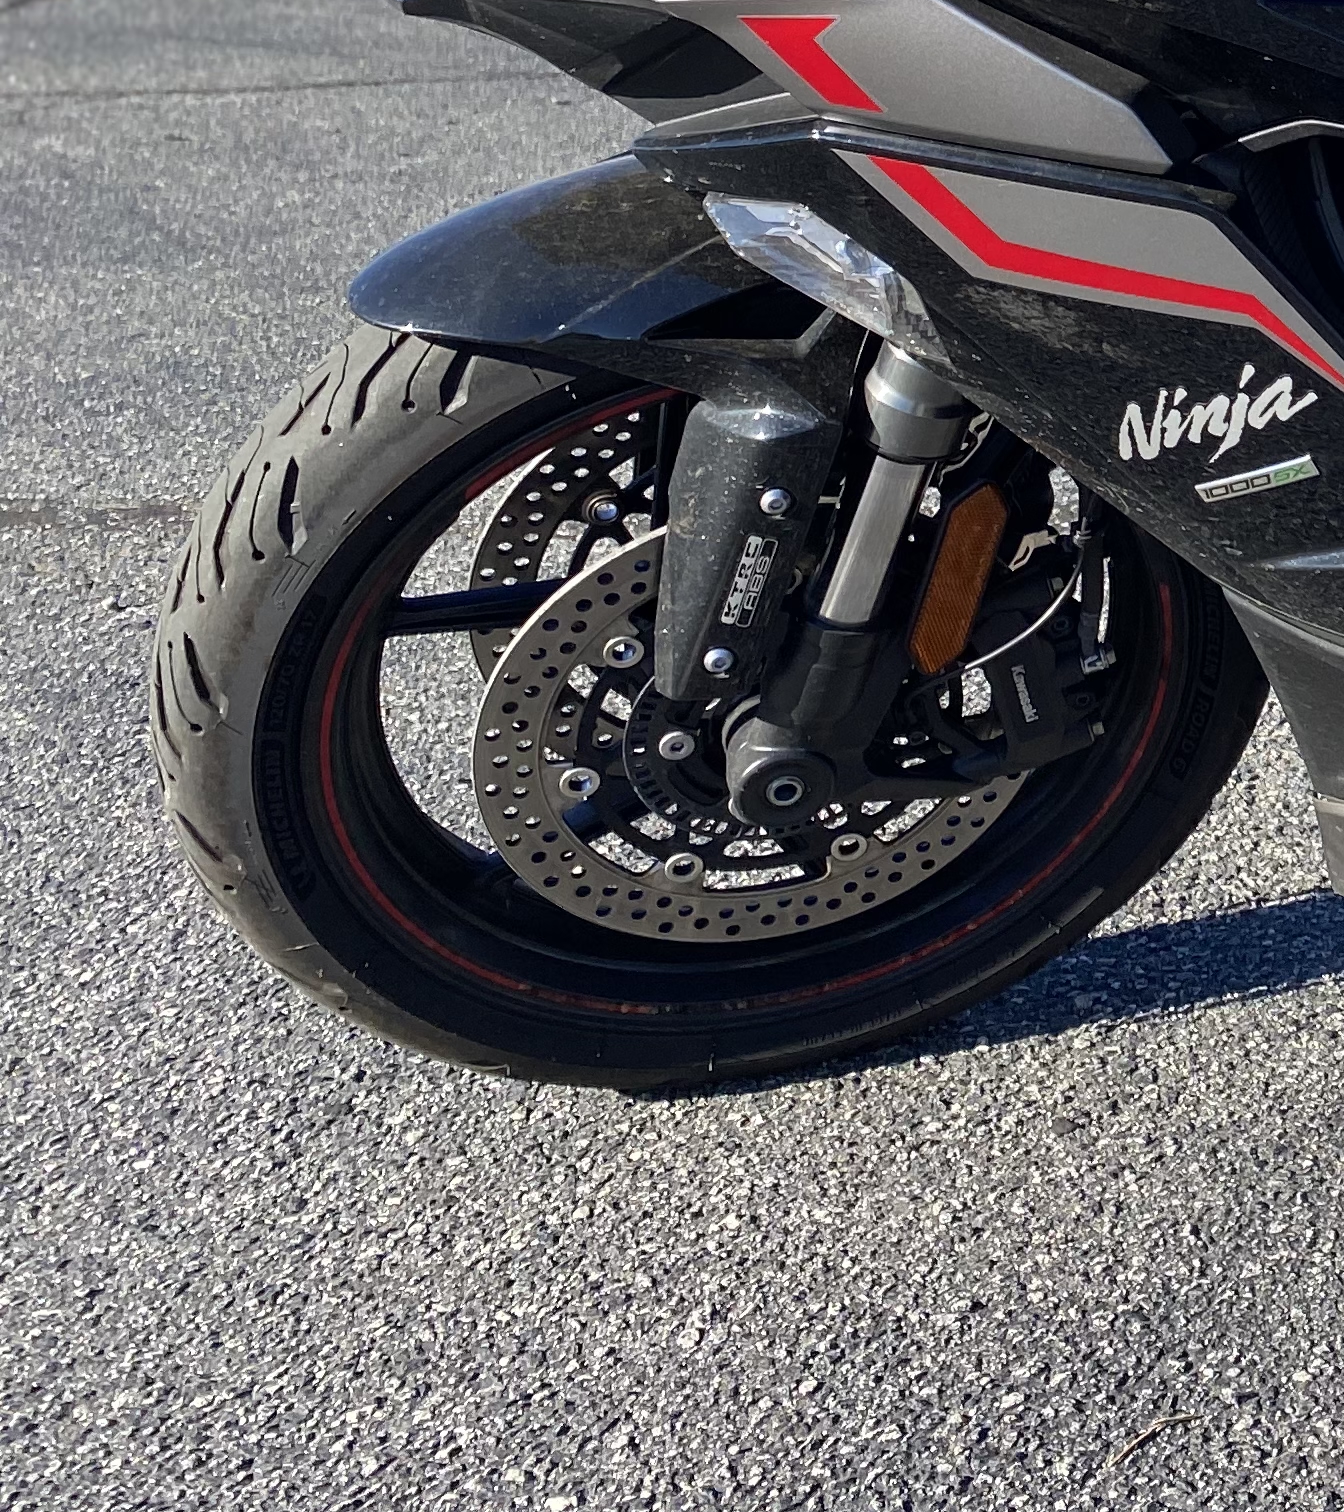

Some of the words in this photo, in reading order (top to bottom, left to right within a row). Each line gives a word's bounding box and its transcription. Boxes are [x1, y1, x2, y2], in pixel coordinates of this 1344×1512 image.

[1118, 362, 1319, 464] Ninja
[724, 541, 760, 619] KTRC
[743, 556, 769, 611] ABS
[1011, 664, 1039, 723] Kawasaki
